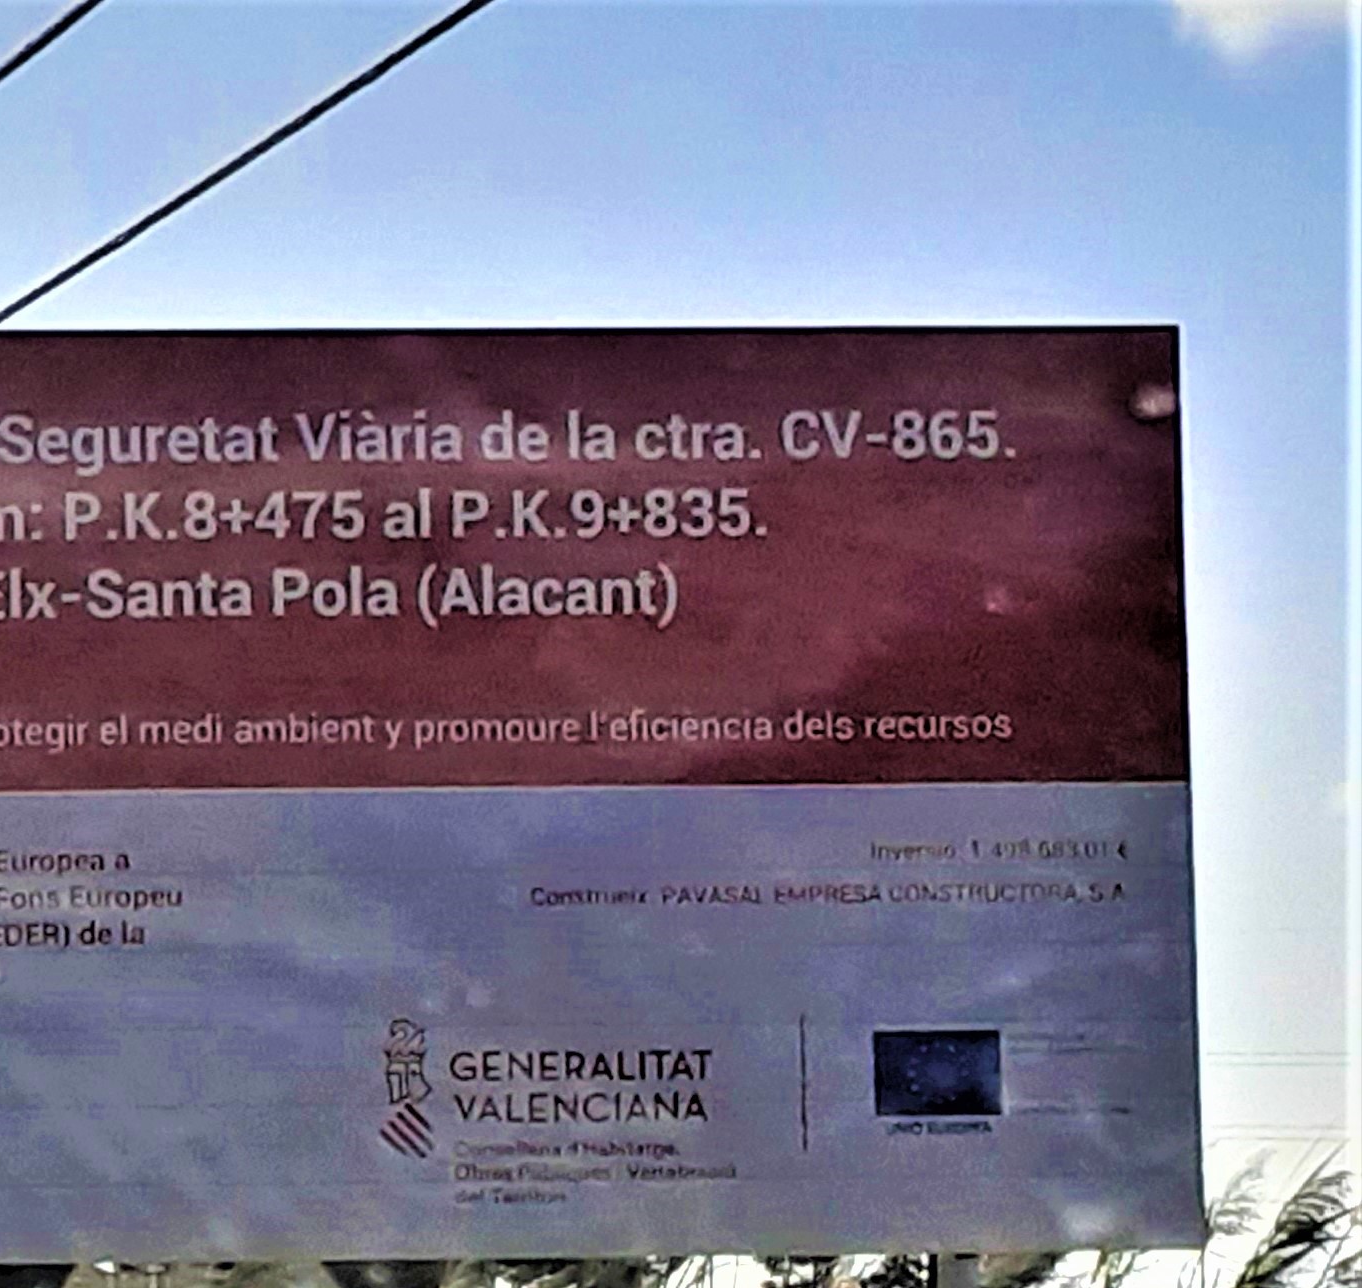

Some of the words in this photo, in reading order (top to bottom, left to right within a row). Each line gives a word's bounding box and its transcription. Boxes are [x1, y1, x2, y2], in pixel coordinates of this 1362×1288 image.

[294, 410, 462, 462] Viària
[481, 409, 547, 461] de
[567, 409, 616, 461] la
[635, 413, 761, 461] ctra.
[782, 409, 1017, 460] CV-865.
[63, 490, 365, 542] P.K.8+475
[384, 488, 431, 539] al
[451, 488, 768, 540] P.K.9+835.
[271, 566, 399, 617] Pola
[417, 561, 679, 629] (Alacant)
[100, 715, 129, 747] el
[139, 714, 222, 746] medi
[234, 713, 374, 746] ambient
[385, 719, 404, 750] y
[414, 717, 578, 749] promoure
[783, 711, 854, 742] dels
[865, 713, 1013, 742] recursos
[114, 853, 130, 872] a
[70, 885, 183, 912] Europeu
[774, 884, 881, 904] EMPRESA
[79, 920, 113, 945] de
[121, 919, 145, 945] la
[450, 1049, 713, 1083] GENERALITAT
[455, 1092, 709, 1124] VALENCIANA
